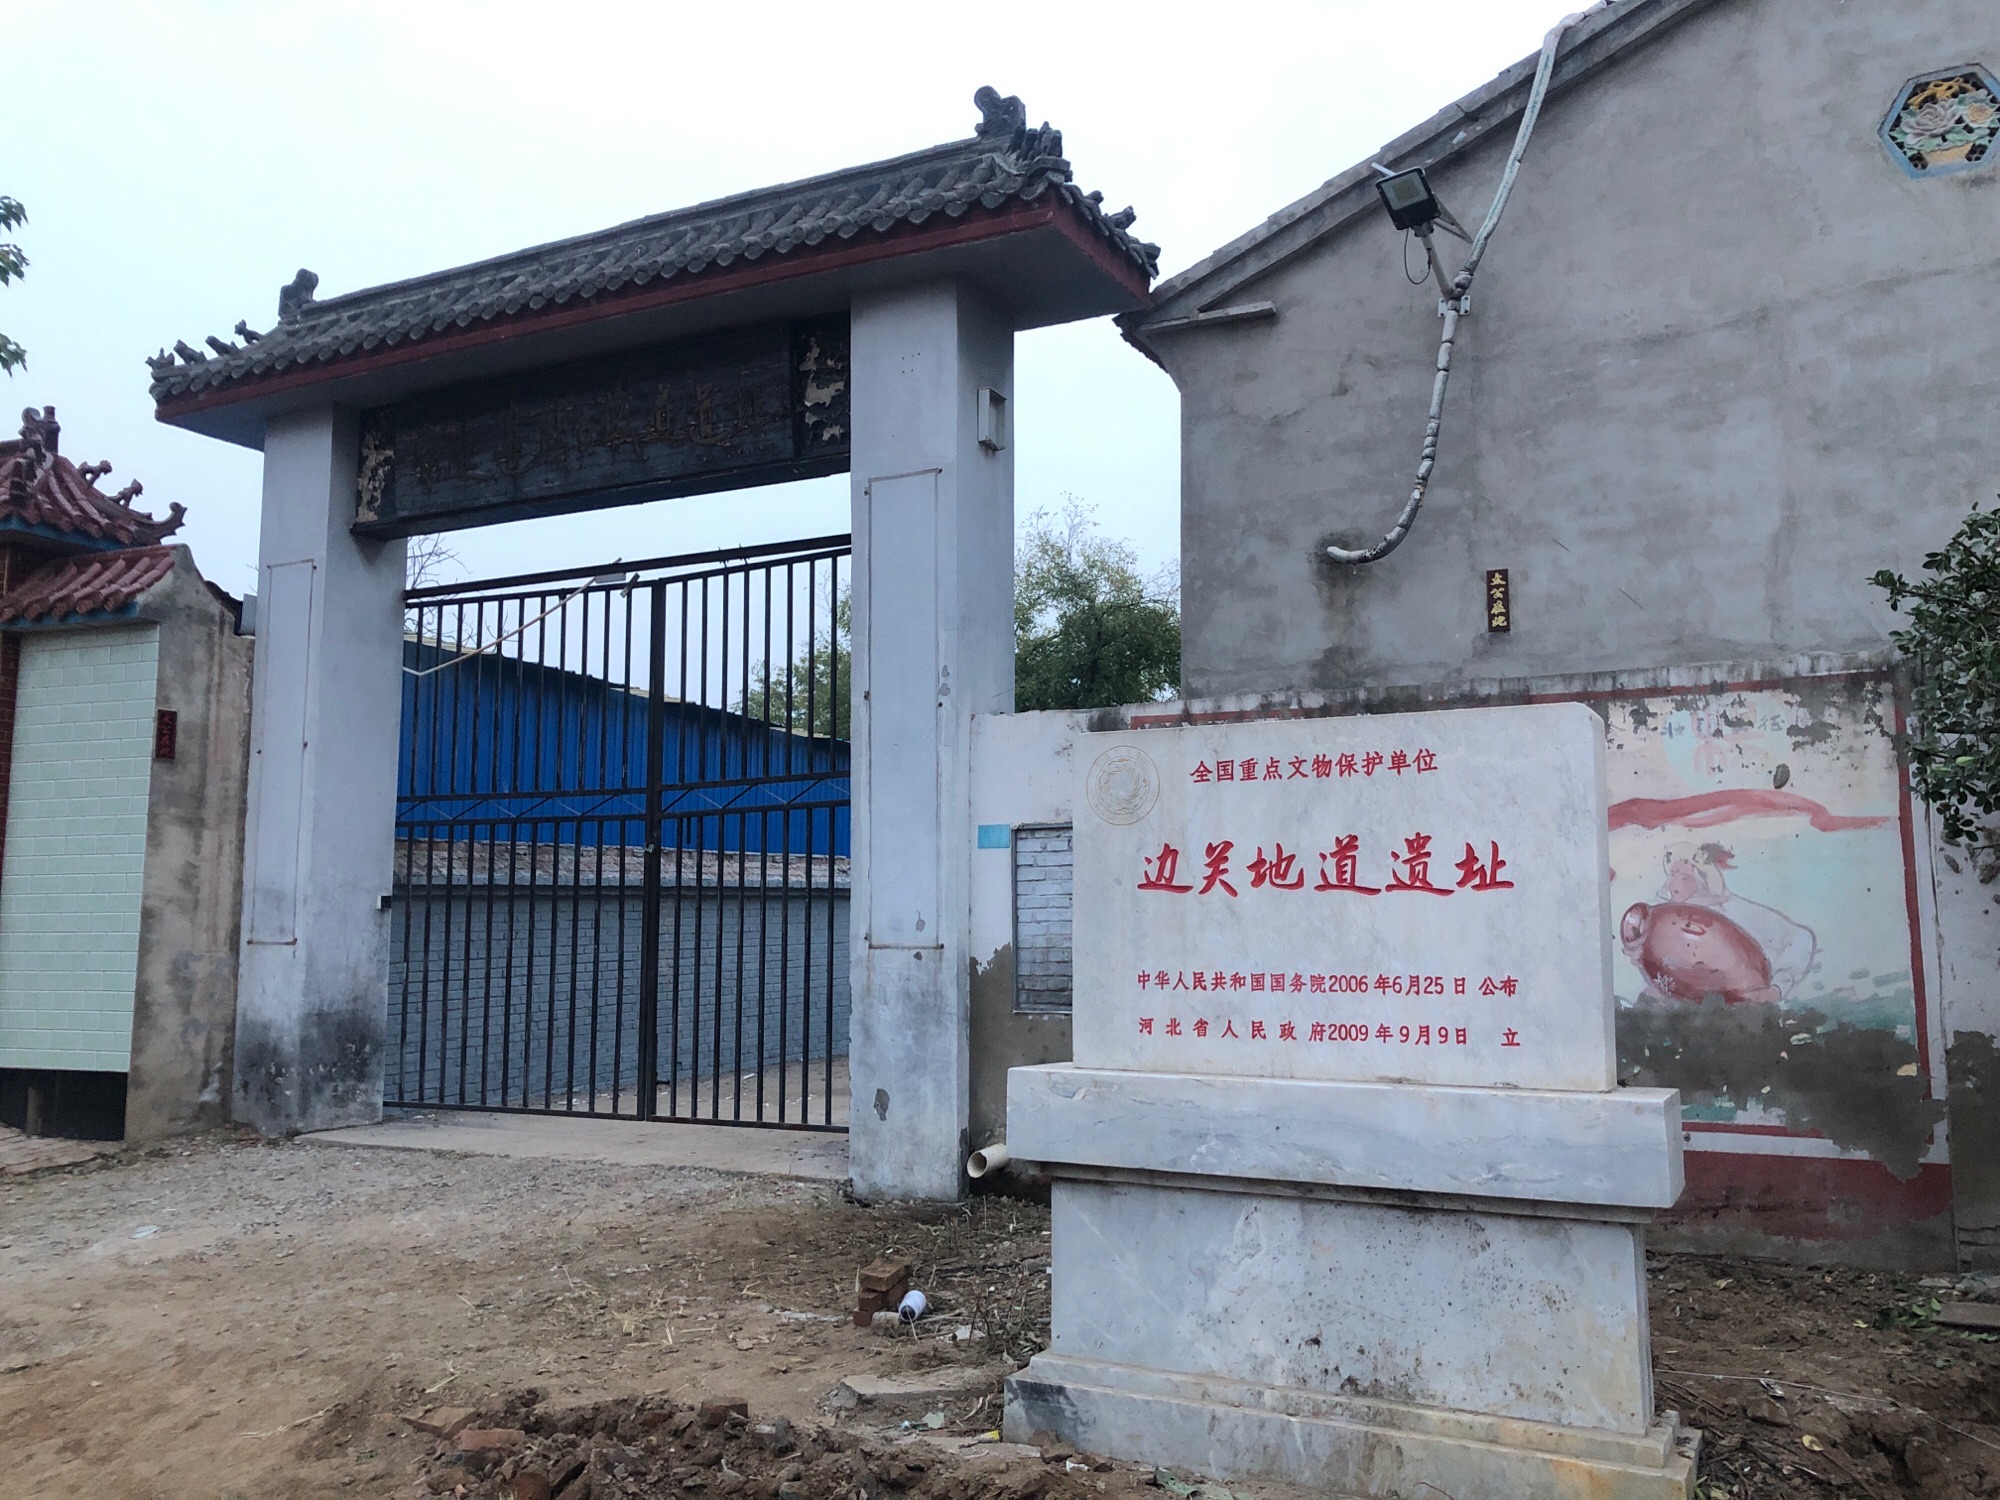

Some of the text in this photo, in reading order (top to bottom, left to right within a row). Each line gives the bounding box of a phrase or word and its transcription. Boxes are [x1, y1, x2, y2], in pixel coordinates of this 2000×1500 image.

[1189, 748, 1438, 783] 全国重点文物保护单位
[1137, 831, 1515, 898] 边关地道遗址
